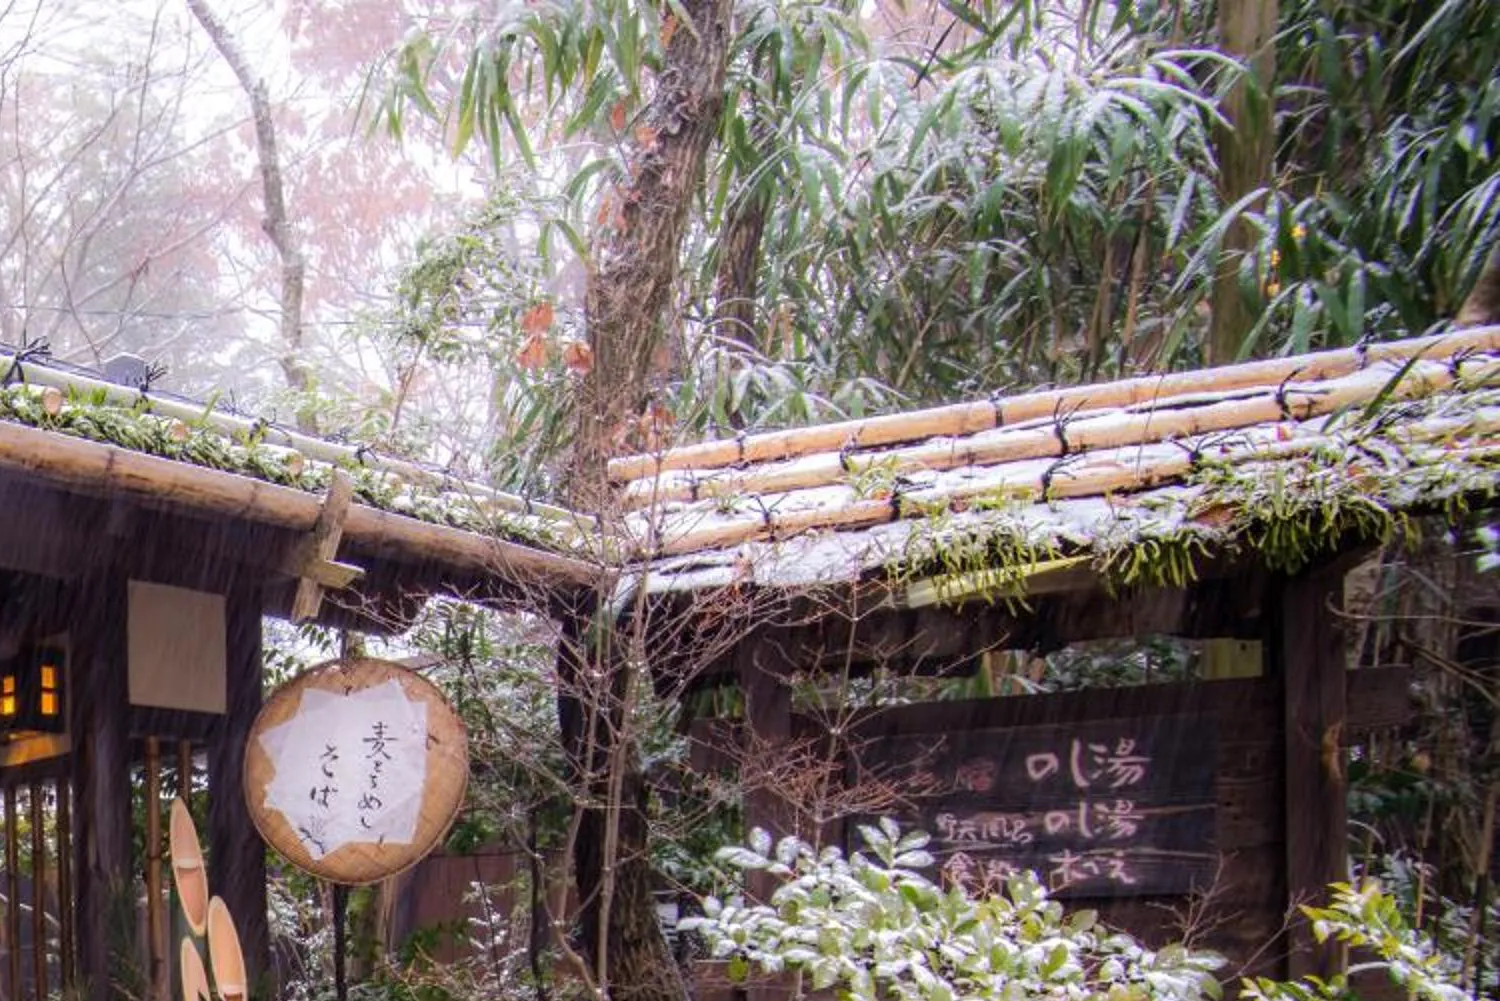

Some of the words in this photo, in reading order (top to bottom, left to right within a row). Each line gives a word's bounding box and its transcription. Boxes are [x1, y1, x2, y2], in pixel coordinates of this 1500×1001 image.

[310, 744, 339, 809] そば
[357, 721, 399, 830] 麦とろめし
[1025, 737, 1153, 789] のし湯
[1044, 799, 1144, 840] のし湯
